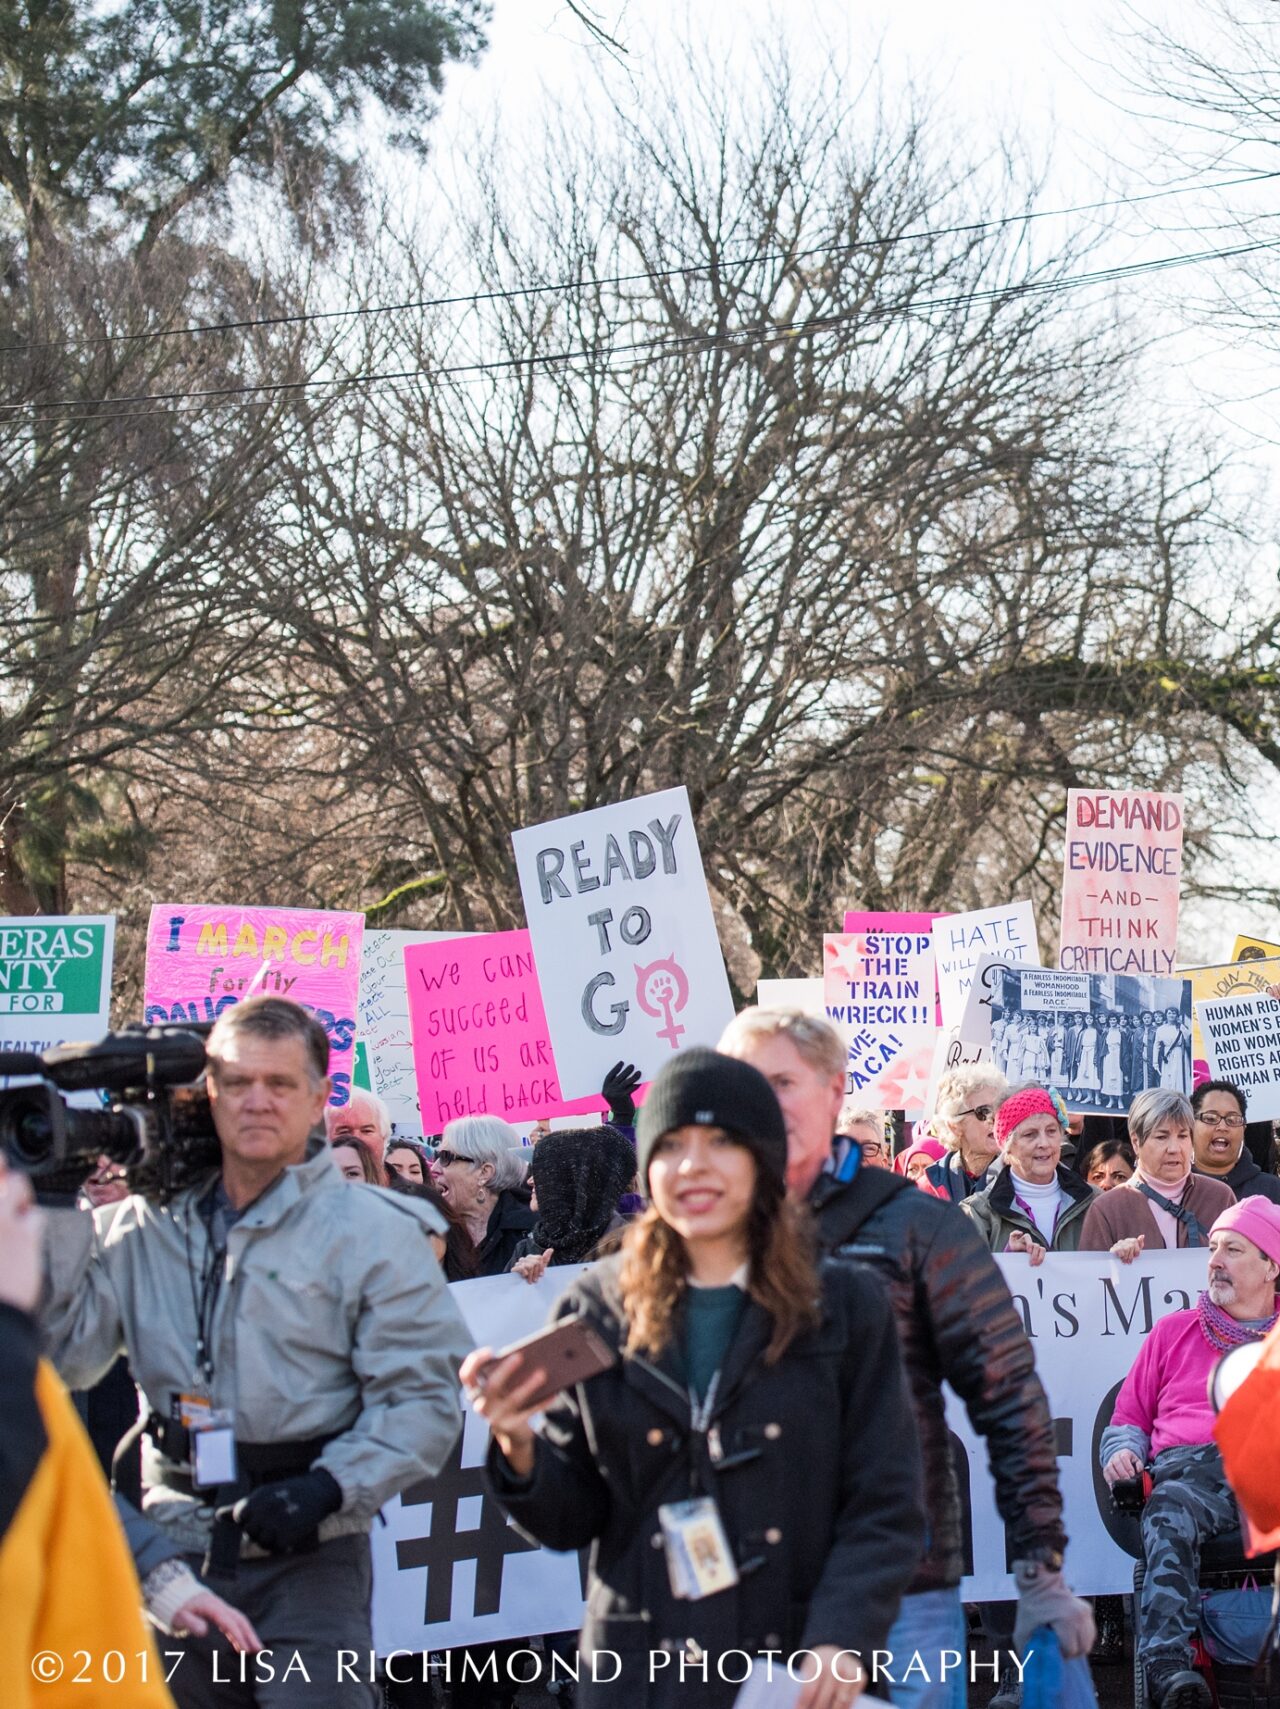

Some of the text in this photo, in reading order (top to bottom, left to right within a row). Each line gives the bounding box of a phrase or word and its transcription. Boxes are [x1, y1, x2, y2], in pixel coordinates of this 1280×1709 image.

[1077, 795, 1181, 832] DEMAND
[536, 815, 682, 904] READY
[1069, 842, 1178, 875] EVIDENCE
[588, 905, 651, 955] TO
[950, 917, 1020, 952] HATE
[1078, 918, 1159, 939] THINK
[166, 916, 348, 968] I MARCH
[865, 936, 930, 954] STOP
[861, 958, 908, 976] THE
[942, 958, 976, 974] WILL
[1060, 946, 1176, 974] CRITICALLY
[420, 962, 460, 991] We
[1035, 982, 1080, 990] WOMANHOOD
[847, 981, 919, 999] TRAIN
[10, 995, 54, 1010] FOR
[1205, 1002, 1254, 1021] HUMAN
[365, 1005, 391, 1025] ALL
[825, 1005, 928, 1024] WRECK!!
[1209, 1017, 1272, 1038] WOMEN'S
[1215, 1039, 1241, 1055] AND
[1218, 1053, 1265, 1072] RIGHTS
[1221, 1069, 1270, 1087] HUMAN
